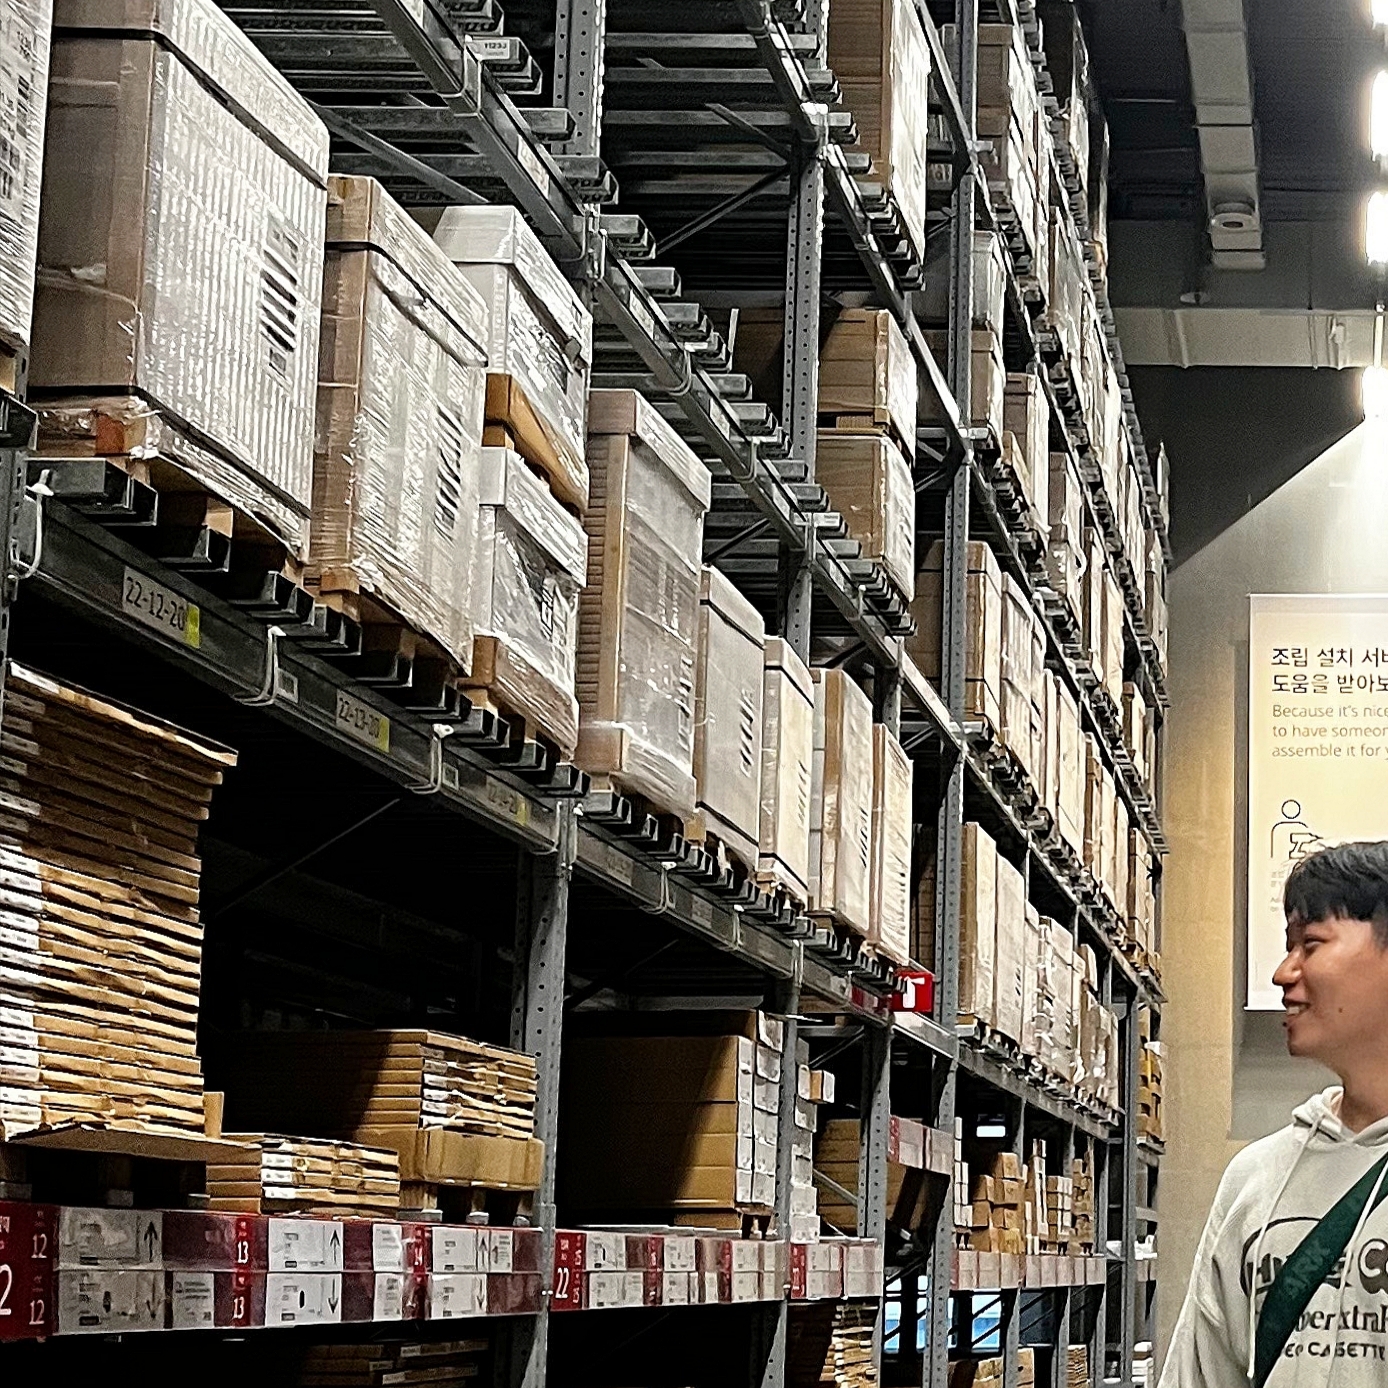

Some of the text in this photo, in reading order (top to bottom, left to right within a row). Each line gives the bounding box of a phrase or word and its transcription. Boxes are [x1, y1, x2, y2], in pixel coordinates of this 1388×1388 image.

[126, 576, 185, 632] 22-12-20
[1271, 647, 1308, 668] 조립
[1317, 647, 1353, 668] 설치
[1271, 673, 1330, 694] 도움을
[1272, 704, 1334, 718] Because
[1338, 704, 1358, 718] it's
[1272, 725, 1287, 738] to
[1292, 724, 1328, 738] have
[1271, 743, 1342, 758] assemble
[1346, 744, 1355, 758] it
[1360, 743, 1380, 758] for
[30, 1232, 48, 1259] 12
[237, 1240, 249, 1264] 13
[554, 1267, 570, 1299] 22
[28, 1299, 46, 1326] 12
[233, 1296, 245, 1320] 13
